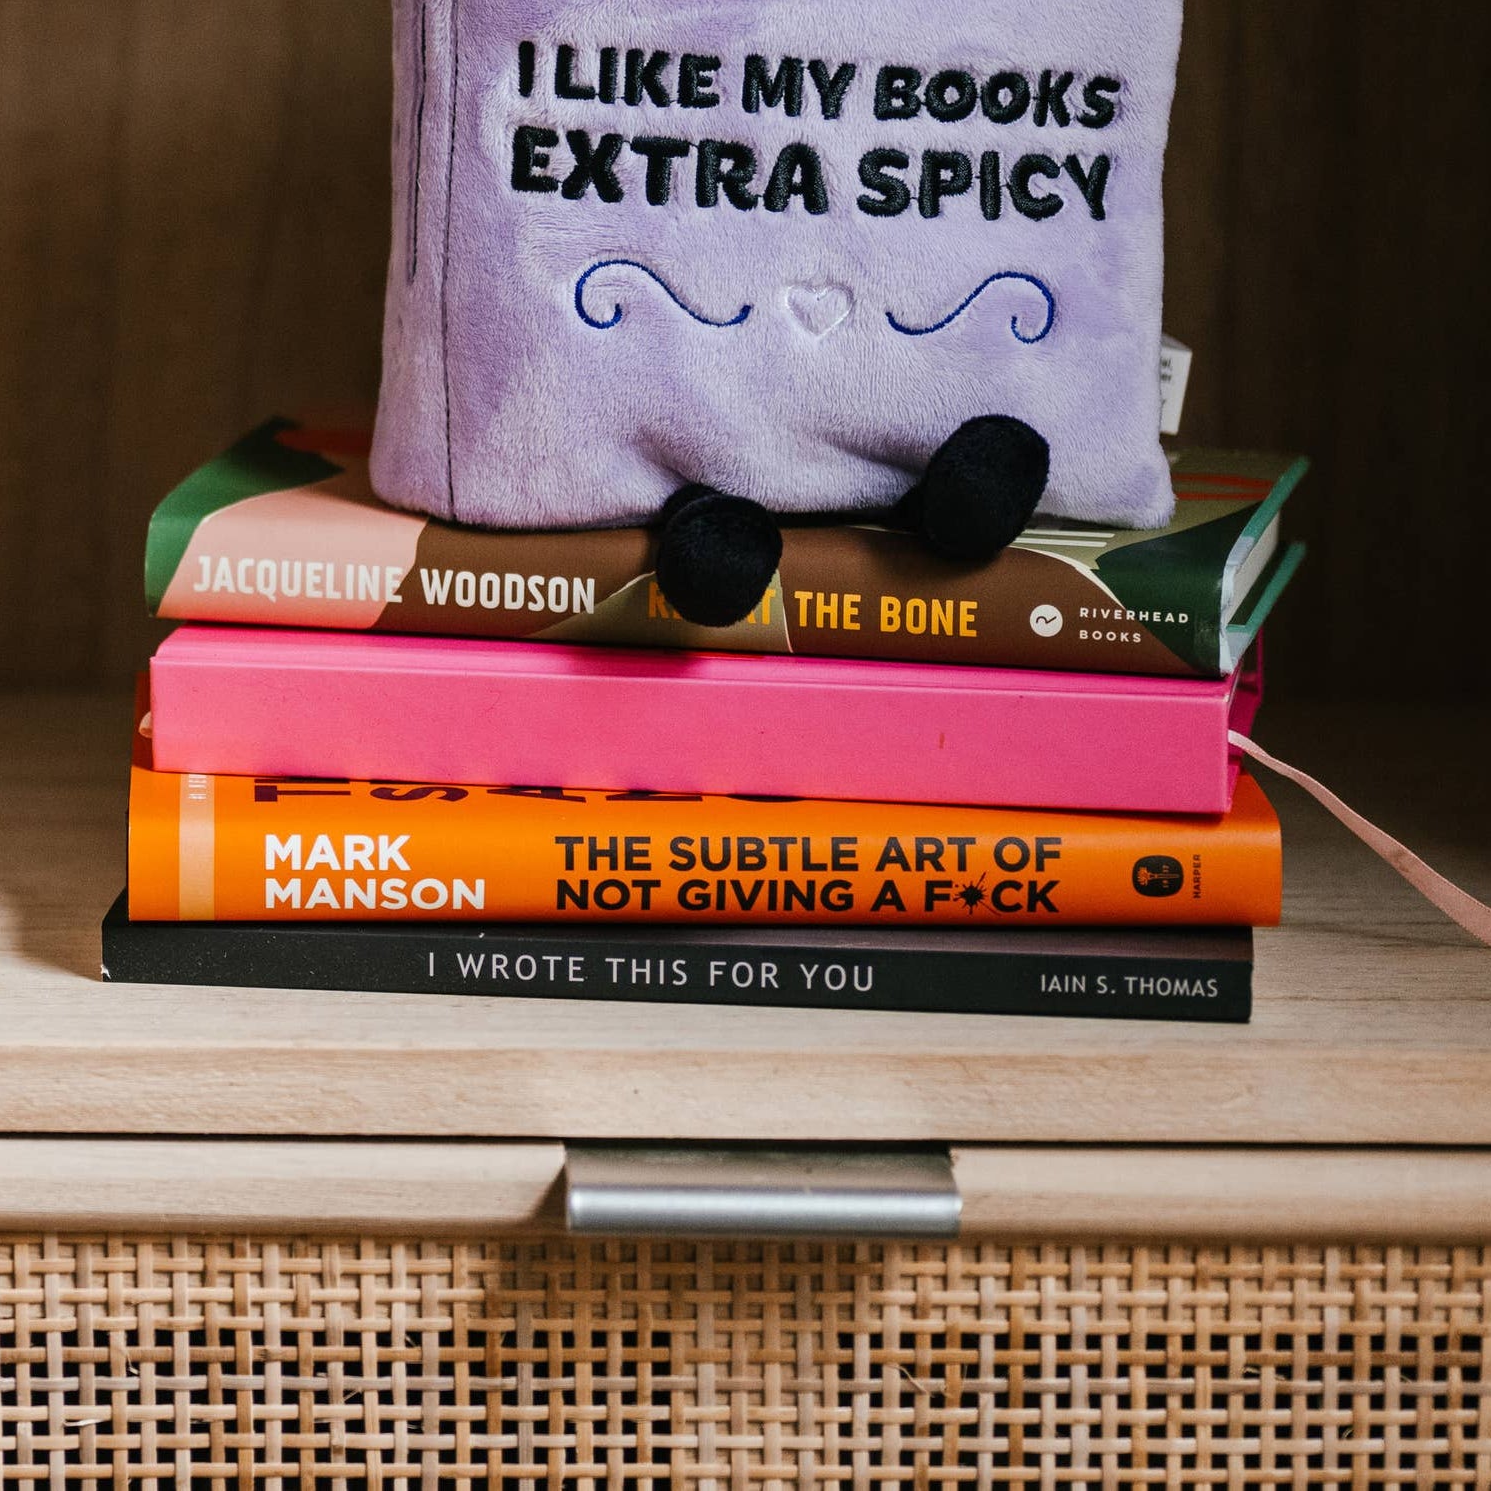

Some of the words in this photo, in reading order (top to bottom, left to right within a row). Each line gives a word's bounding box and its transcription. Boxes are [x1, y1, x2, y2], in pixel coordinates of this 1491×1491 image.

[515, 40, 537, 98] I
[552, 45, 723, 112] LIKE
[740, 52, 858, 121] MY
[874, 64, 1123, 130] BOOKS
[509, 125, 830, 216] EXTRA
[856, 147, 1113, 223] SPICY
[192, 554, 404, 605] JACQUELINE
[419, 567, 596, 615] WOODSON
[794, 589, 862, 630] THE
[879, 595, 979, 639] BONE
[1078, 606, 1190, 624] RIVERHEAD
[1078, 628, 1143, 645] BOOKS
[264, 833, 411, 871] MARK
[554, 835, 653, 872] THE
[668, 835, 859, 873] SUBTLE
[875, 835, 977, 873] ART
[992, 835, 1063, 873] OF
[264, 876, 486, 911] MANSON
[555, 877, 660, 912] NOT
[676, 878, 854, 913] GIVING
[870, 879, 910, 912] A
[1191, 853, 1202, 900] HARPER
[427, 951, 435, 978] I
[456, 952, 586, 983] WROTE
[604, 957, 689, 987] THIS
[708, 961, 780, 990] FOR
[799, 963, 875, 993] YOU
[1039, 973, 1087, 994] IAIN
[1095, 975, 1117, 995] S.
[1126, 976, 1220, 999] THOMAS
